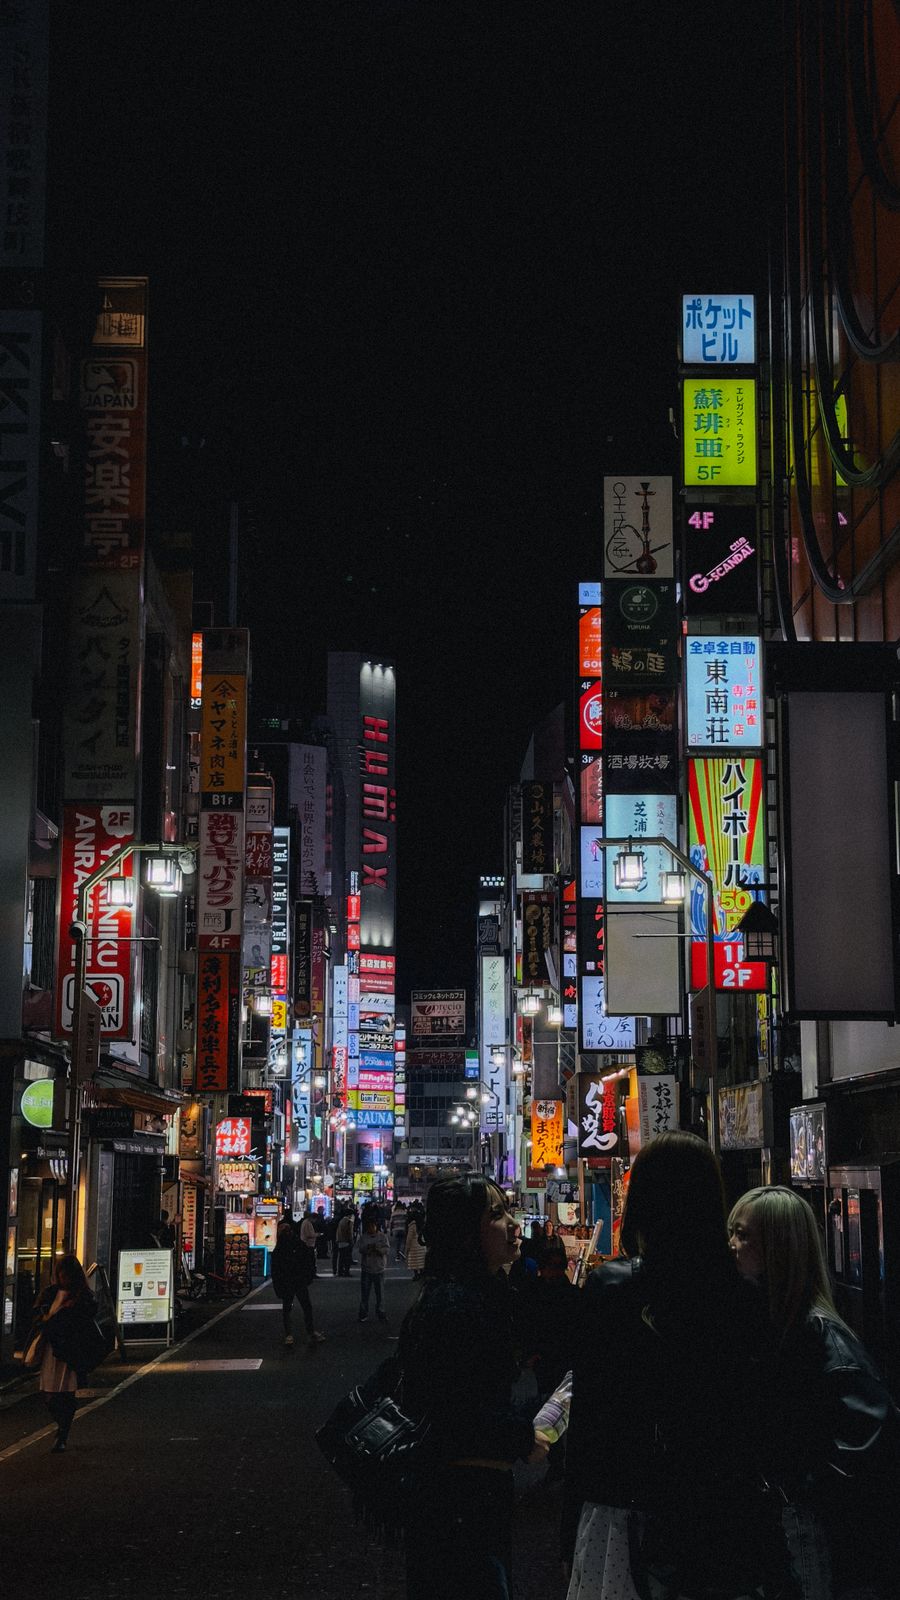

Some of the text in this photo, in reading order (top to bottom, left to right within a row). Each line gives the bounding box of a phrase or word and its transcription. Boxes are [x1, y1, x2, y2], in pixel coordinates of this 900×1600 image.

[685, 299, 752, 330] ポケット
[702, 333, 738, 362] ビル
[86, 394, 134, 408] JAPAN
[736, 388, 745, 464] エレガンス・ラウンジ
[697, 466, 722, 480] 5F
[85, 415, 131, 556] 安楽亭
[688, 512, 714, 529] 4F
[120, 556, 140, 569] 2F
[689, 545, 755, 593] G-SCANDAL
[690, 641, 756, 655] 全卓全自動
[581, 682, 592, 690] 4F
[744, 658, 757, 726] リーチ麻雀
[704, 659, 730, 744] 東南荘
[207, 701, 226, 788] ヤマネ肉店
[690, 734, 703, 744] 3F
[582, 755, 594, 764] 3F
[608, 755, 670, 769] 酒場牧場
[212, 794, 232, 806] B1F
[362, 714, 395, 890] HUMAX
[108, 812, 130, 826] 2F
[721, 764, 749, 887] ハイボール
[720, 891, 751, 910] 50
[208, 936, 231, 949] 4F
[723, 969, 752, 986] 2F
[65, 1013, 119, 1027] JAN
[357, 1111, 393, 1124] SAUNA
